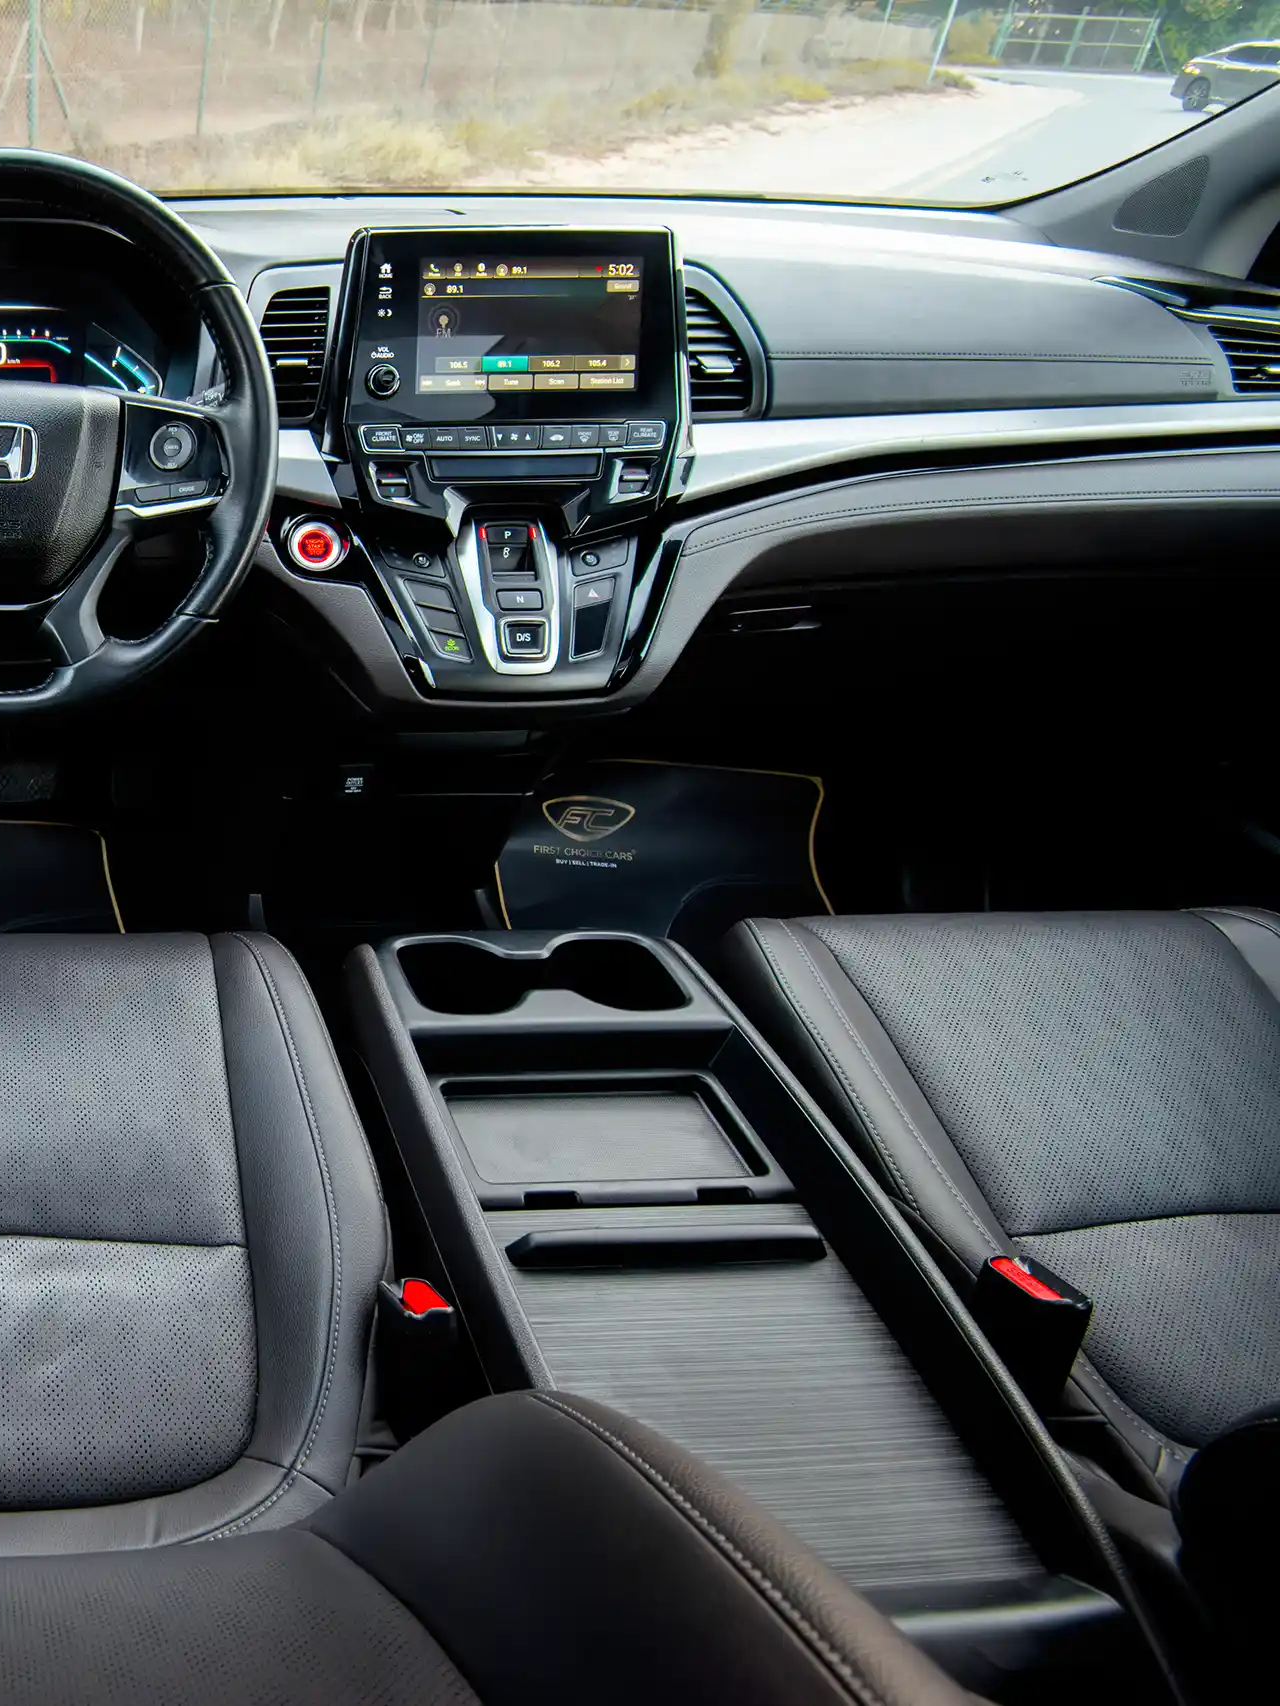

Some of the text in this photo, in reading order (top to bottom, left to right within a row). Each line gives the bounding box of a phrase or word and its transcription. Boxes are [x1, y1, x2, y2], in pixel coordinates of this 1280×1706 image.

[511, 266, 527, 274] 89.1
[608, 264, 634, 276] 5:02
[446, 284, 464, 294] 89.1
[436, 328, 451, 338] FM
[590, 377, 612, 385] Station
[504, 530, 512, 540] P
[516, 596, 525, 604] N
[516, 632, 531, 643] D/S
[533, 845, 561, 855] FIRST
[605, 851, 633, 861] CARS
[590, 861, 617, 869] TRADE-IN
